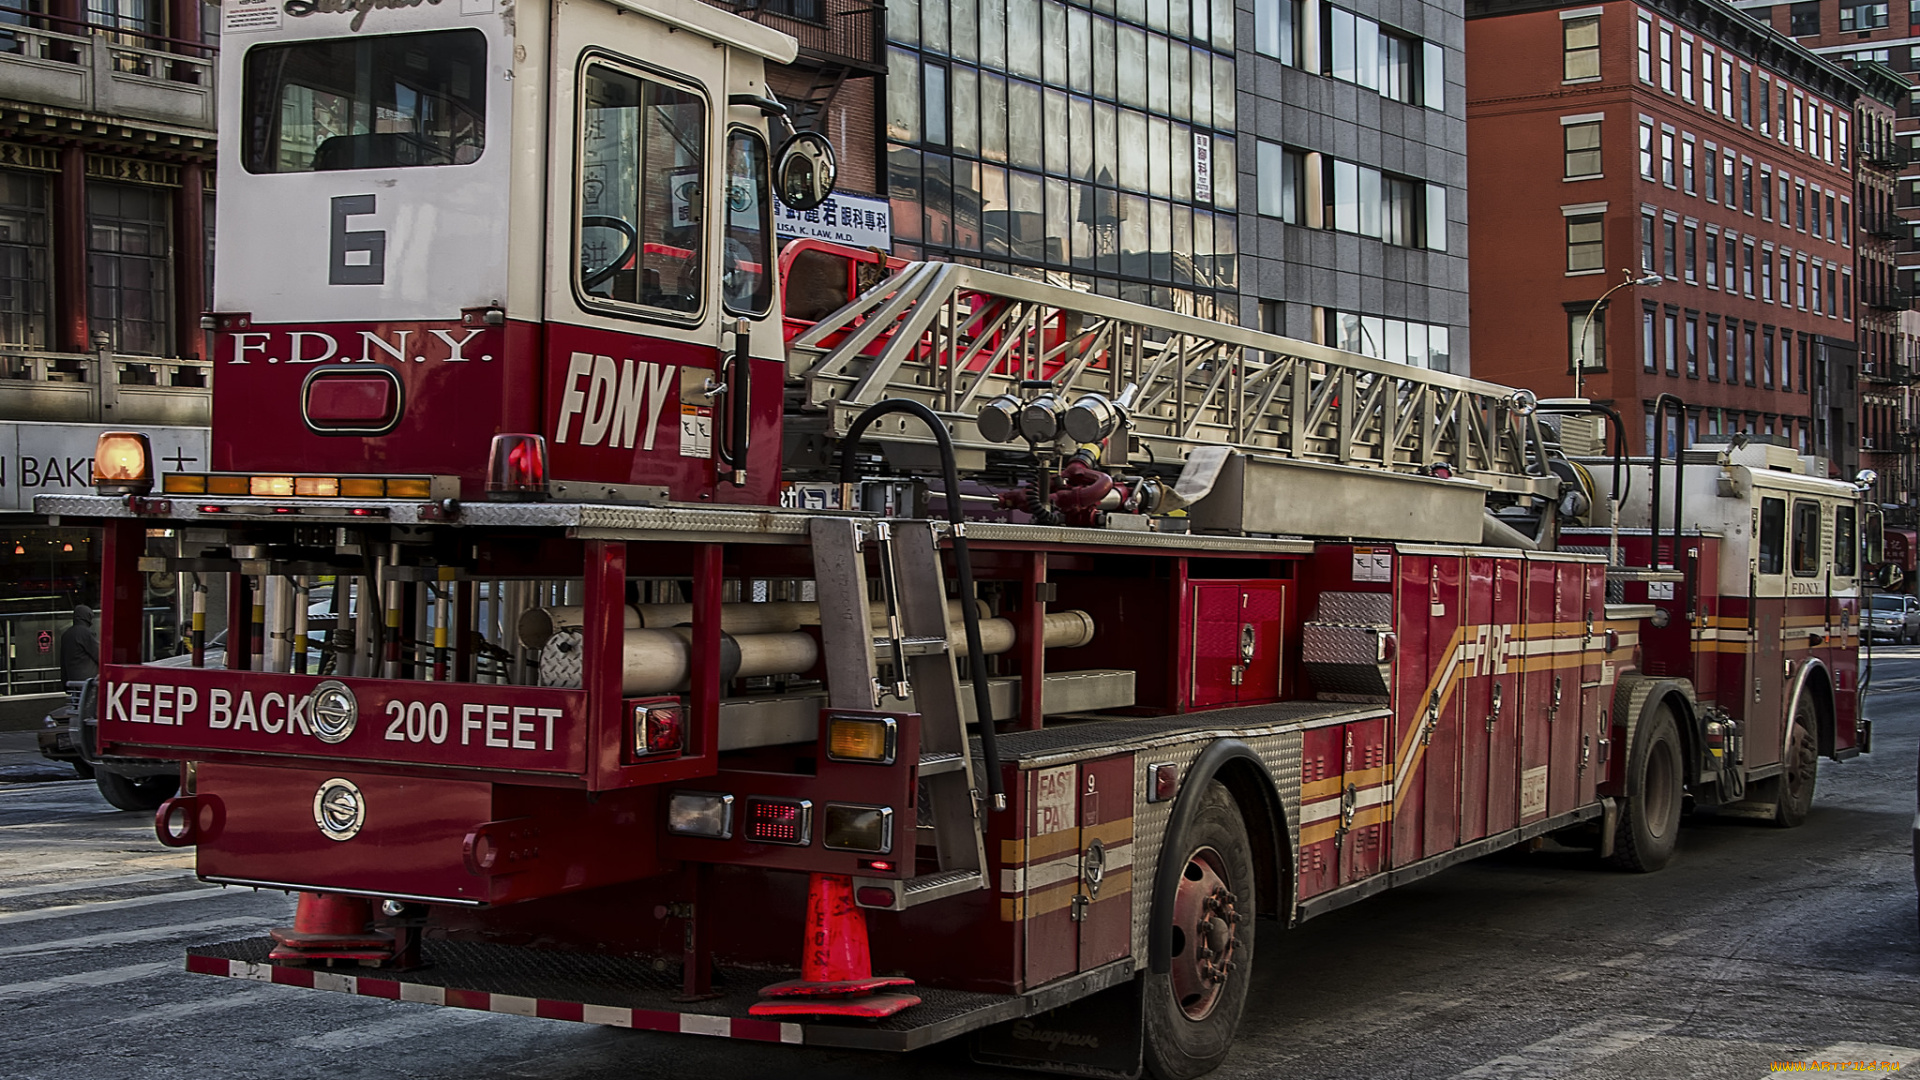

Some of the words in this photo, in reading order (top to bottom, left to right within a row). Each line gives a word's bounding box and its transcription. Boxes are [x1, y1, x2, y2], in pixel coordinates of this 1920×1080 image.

[329, 193, 386, 286] 6
[777, 222, 796, 233] LISA
[799, 226, 809, 235] K.
[812, 228, 832, 240] LAW,
[835, 232, 855, 243] M.D.
[228, 329, 493, 364] F.D.N.Y.
[555, 351, 677, 451] FDNY
[1242, 593, 1249, 608] 7
[1473, 624, 1511, 677] FIRE
[106, 681, 197, 726] KEEP
[209, 687, 312, 736] BACK
[384, 700, 449, 744] 200
[461, 703, 562, 750] FEET
[1040, 771, 1073, 799] FAST
[1088, 774, 1096, 793] 9
[1044, 804, 1071, 834] PAK
